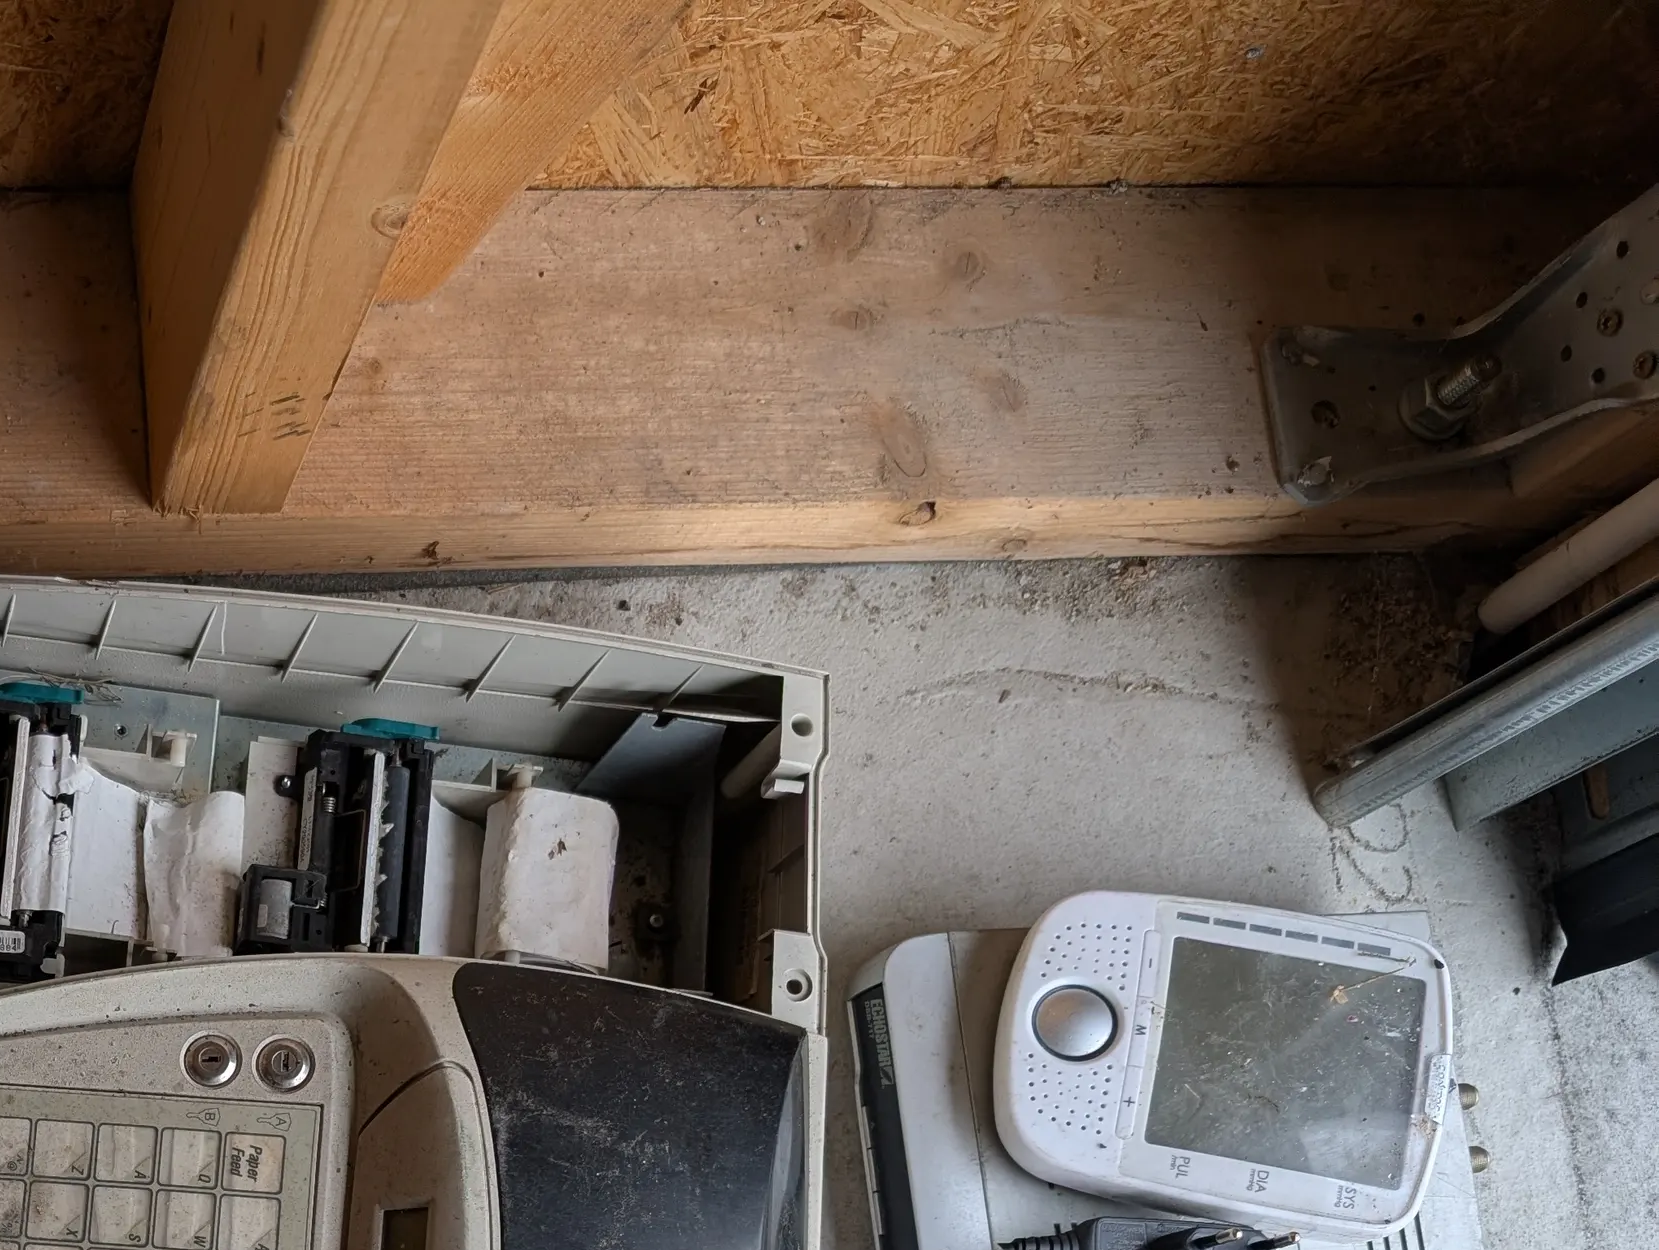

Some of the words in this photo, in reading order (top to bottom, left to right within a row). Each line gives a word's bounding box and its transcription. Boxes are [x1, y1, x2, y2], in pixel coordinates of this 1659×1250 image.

[870, 999, 892, 1067] ECHOSTAR
[71, 1165, 84, 1175] Z
[230, 1147, 245, 1177] Feed
[247, 1144, 263, 1182] Paper
[1175, 1156, 1191, 1179] PUL
[134, 1170, 147, 1179] A
[198, 1174, 212, 1184] Q
[1254, 1170, 1270, 1193] DIA
[1342, 1186, 1357, 1209] SYS
[66, 1227, 78, 1238] X
[129, 1233, 141, 1242] S
[194, 1236, 206, 1247] W
